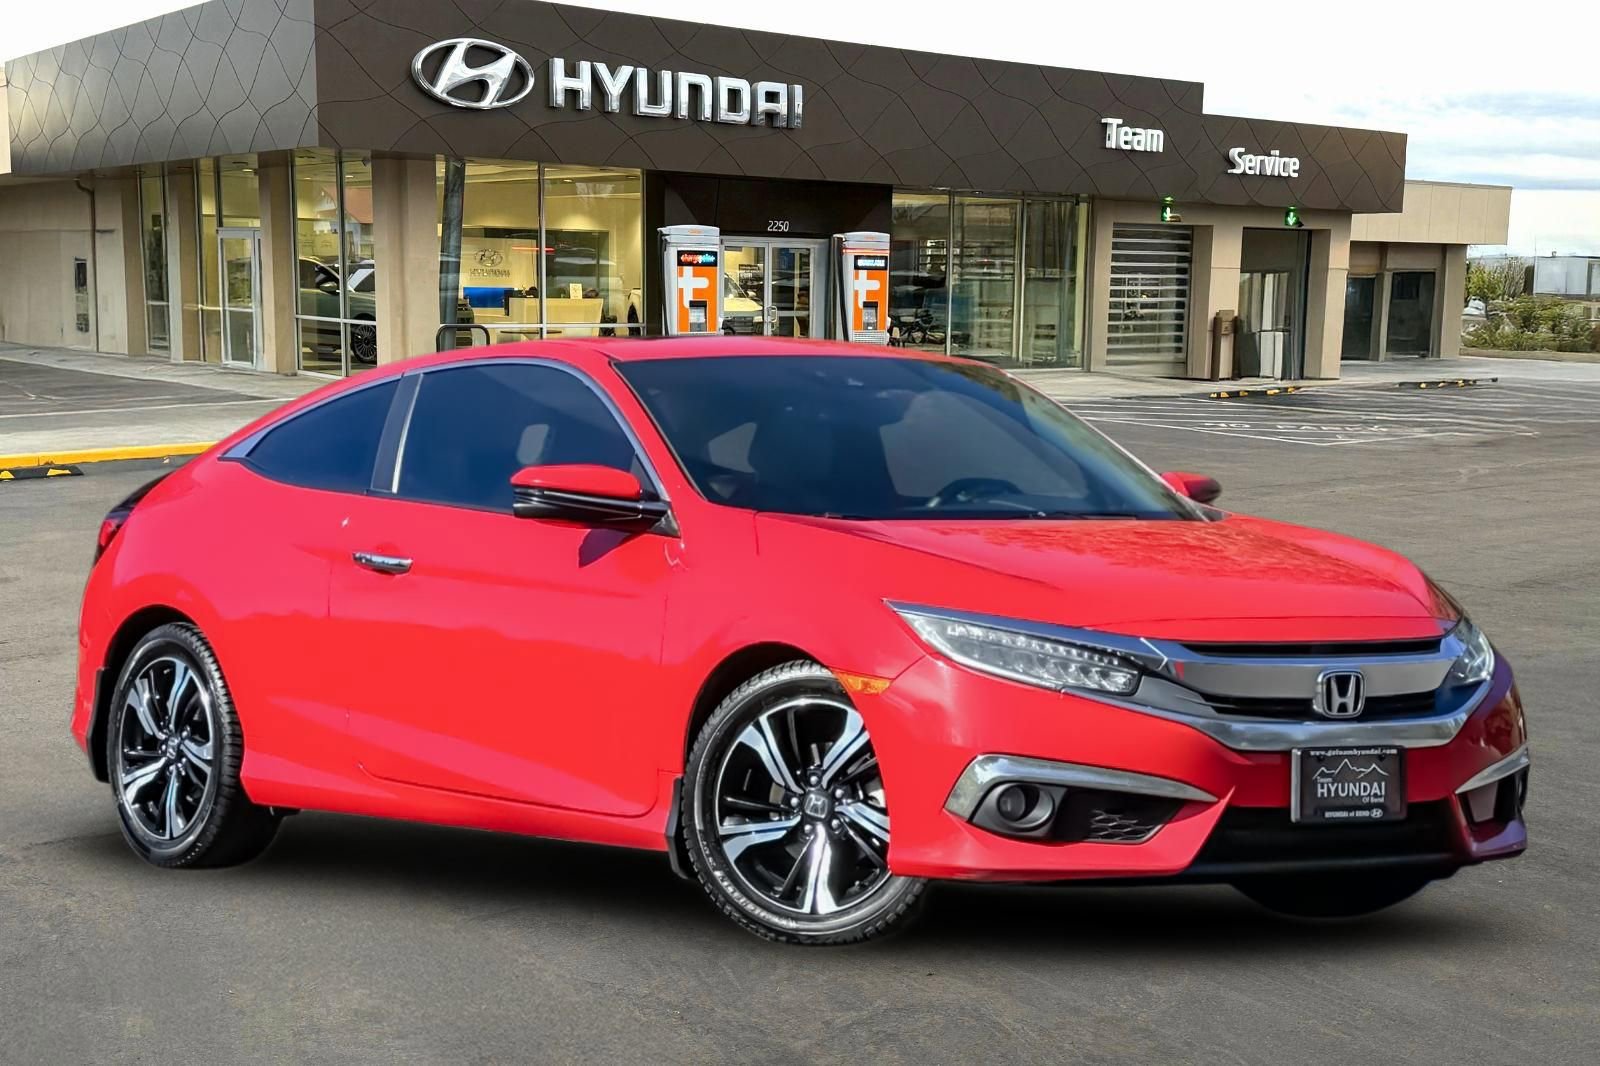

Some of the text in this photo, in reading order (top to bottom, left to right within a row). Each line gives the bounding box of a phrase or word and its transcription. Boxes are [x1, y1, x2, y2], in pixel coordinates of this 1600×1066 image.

[548, 57, 803, 129] HYUNDAI
[1101, 117, 1164, 152] Team
[1227, 147, 1300, 178] Service
[767, 220, 790, 232] 2250
[1317, 782, 1385, 798] HYUNDAI
